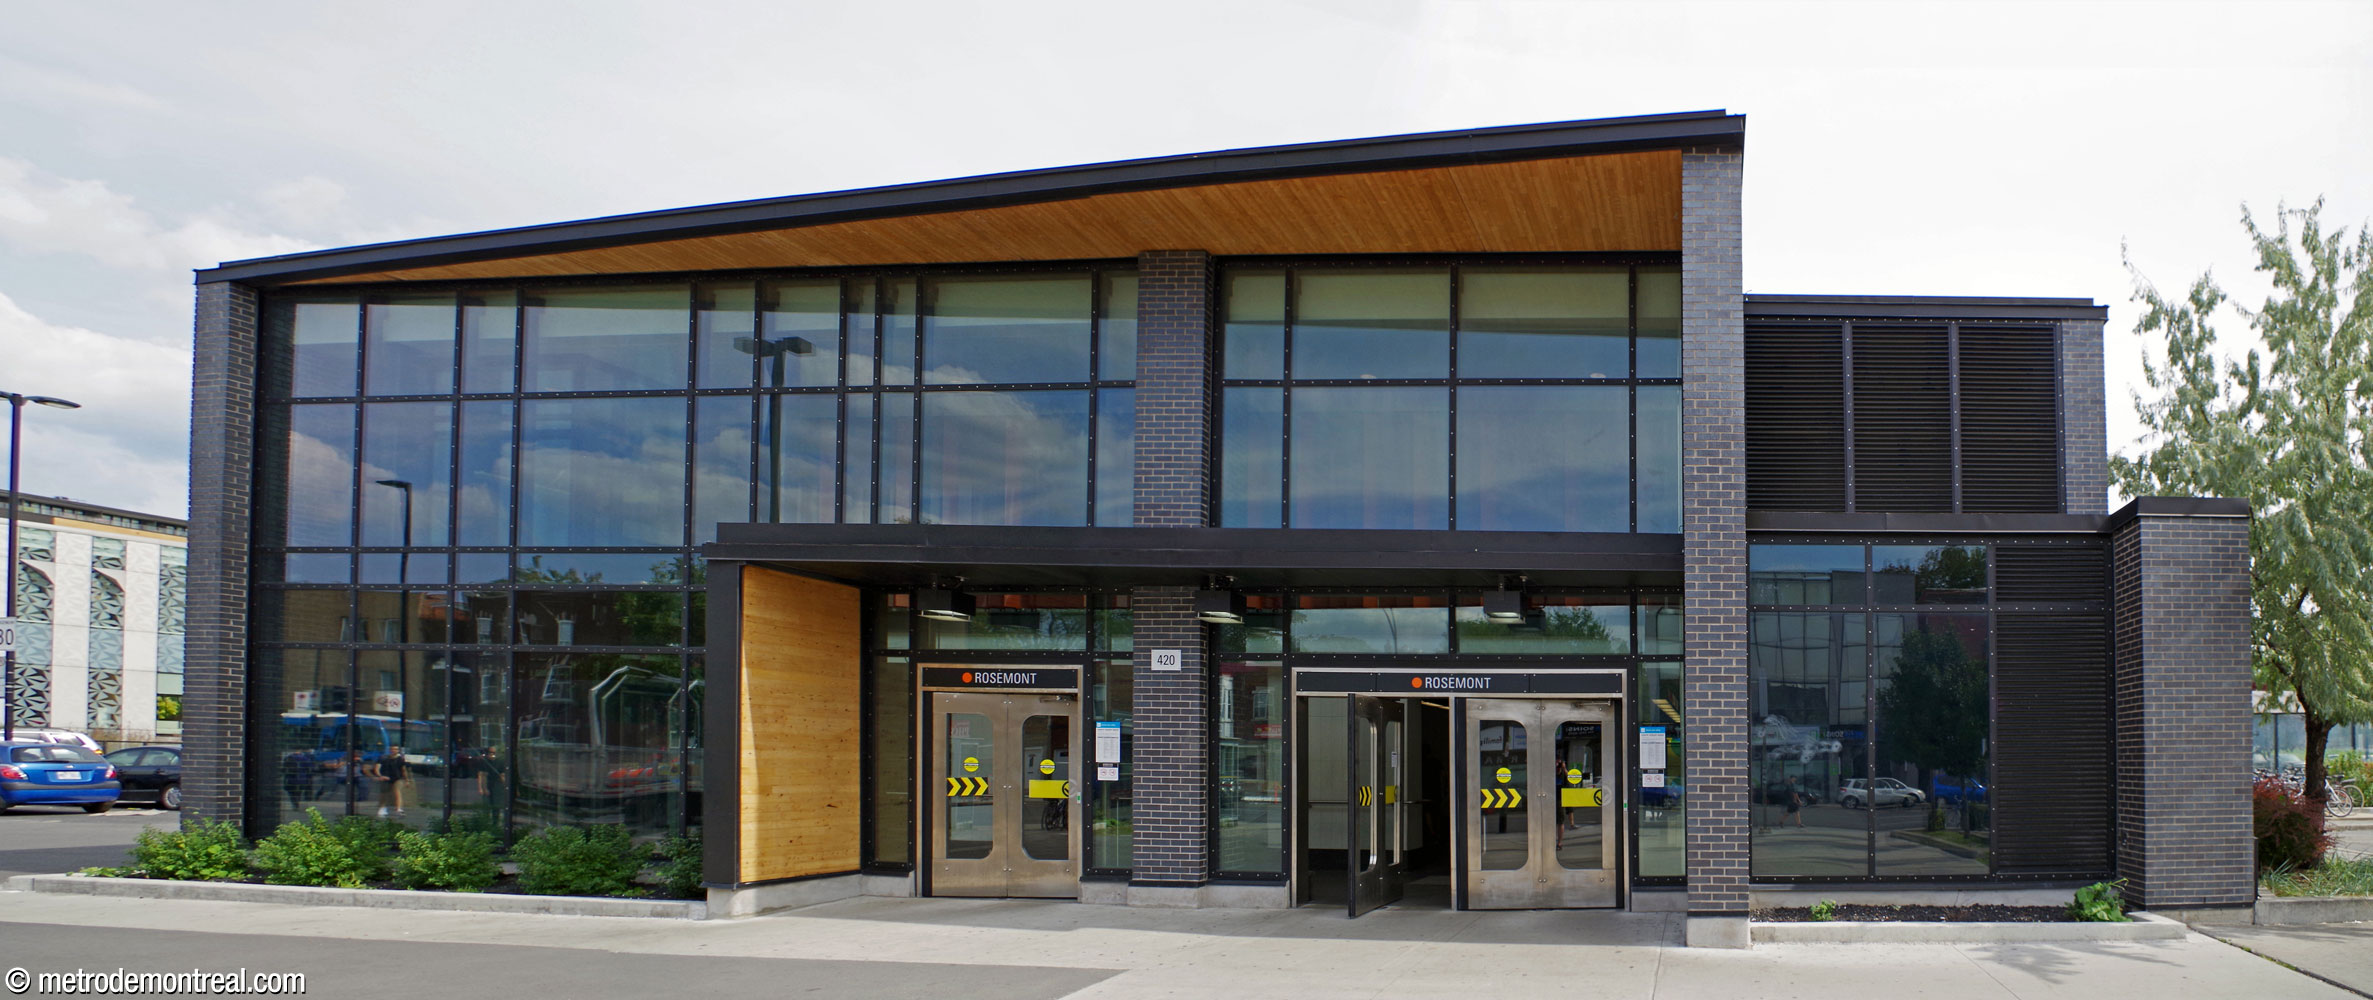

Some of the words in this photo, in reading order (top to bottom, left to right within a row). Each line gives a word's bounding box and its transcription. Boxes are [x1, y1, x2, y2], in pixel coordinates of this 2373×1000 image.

[1157, 654, 1175, 666] 420
[974, 672, 1037, 684] ROSEMONT
[1425, 677, 1491, 689] ROSEMONT
